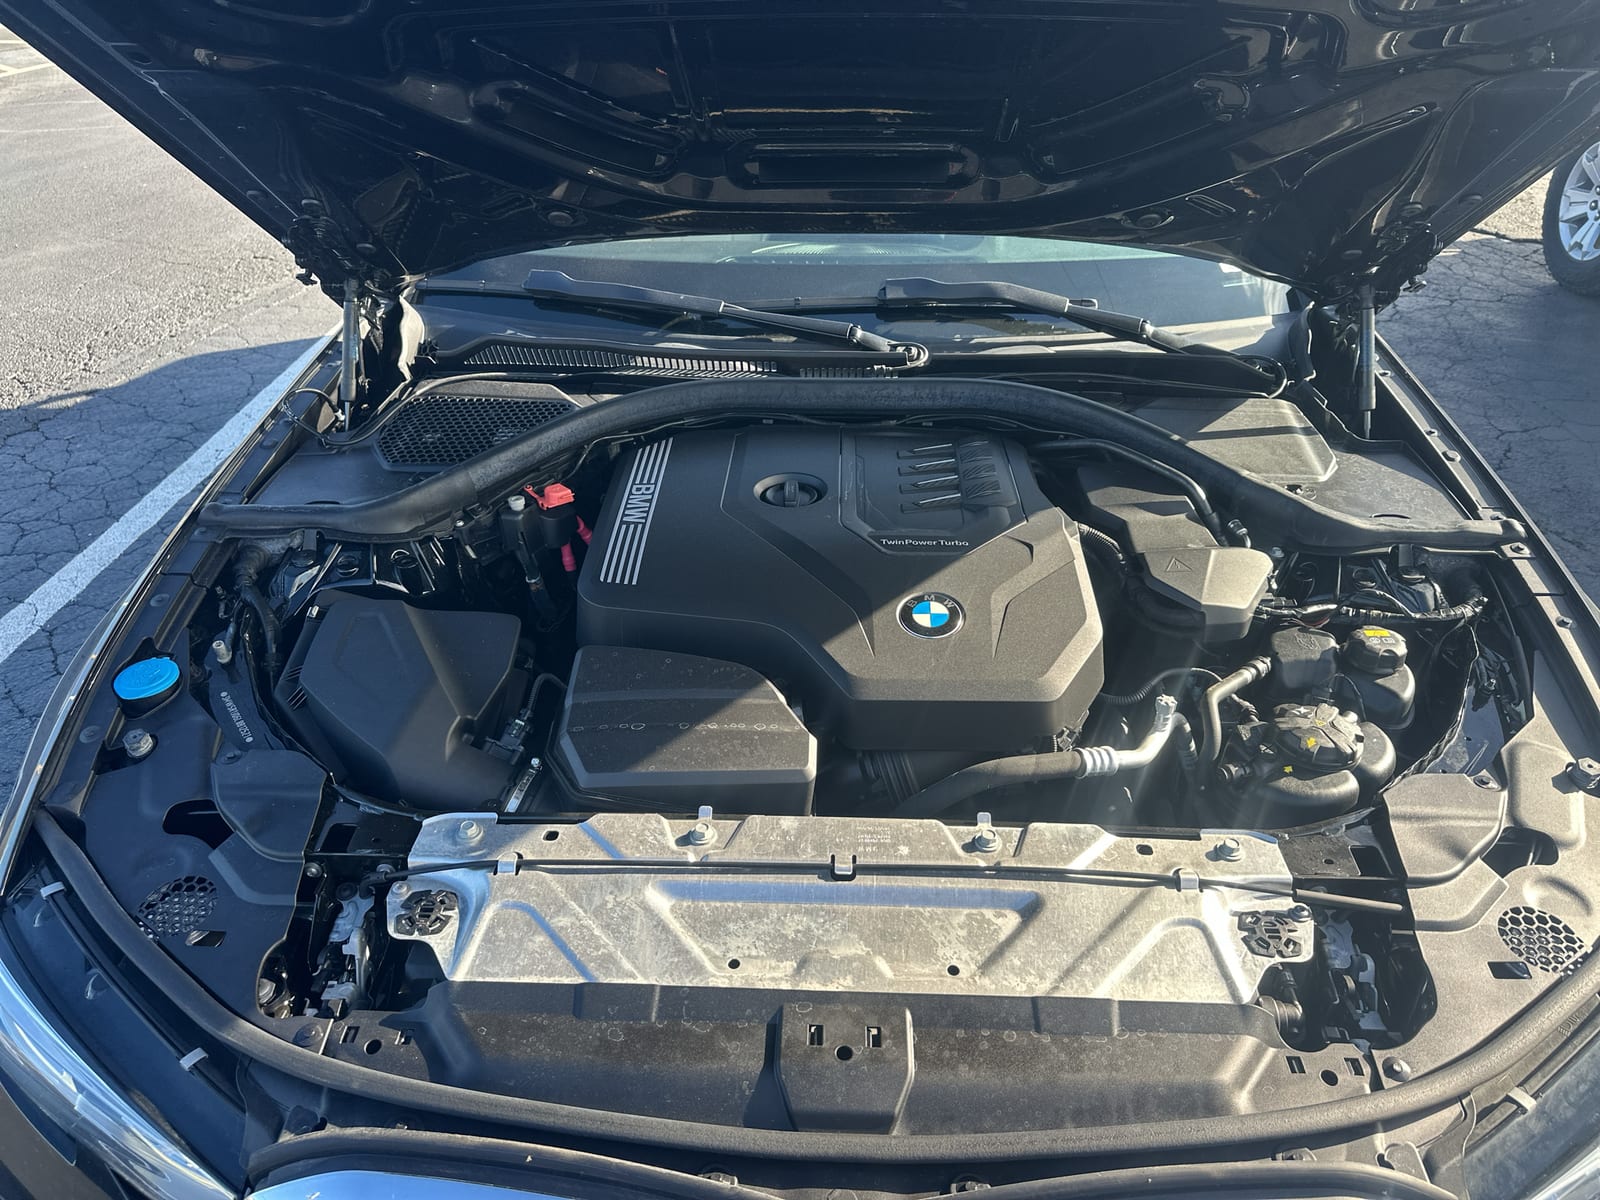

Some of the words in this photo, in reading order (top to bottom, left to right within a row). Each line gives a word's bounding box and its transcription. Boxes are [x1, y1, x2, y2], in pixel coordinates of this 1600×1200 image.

[622, 484, 655, 523] BMW
[880, 538, 937, 546] TwinPower
[907, 594, 955, 608] BMW
